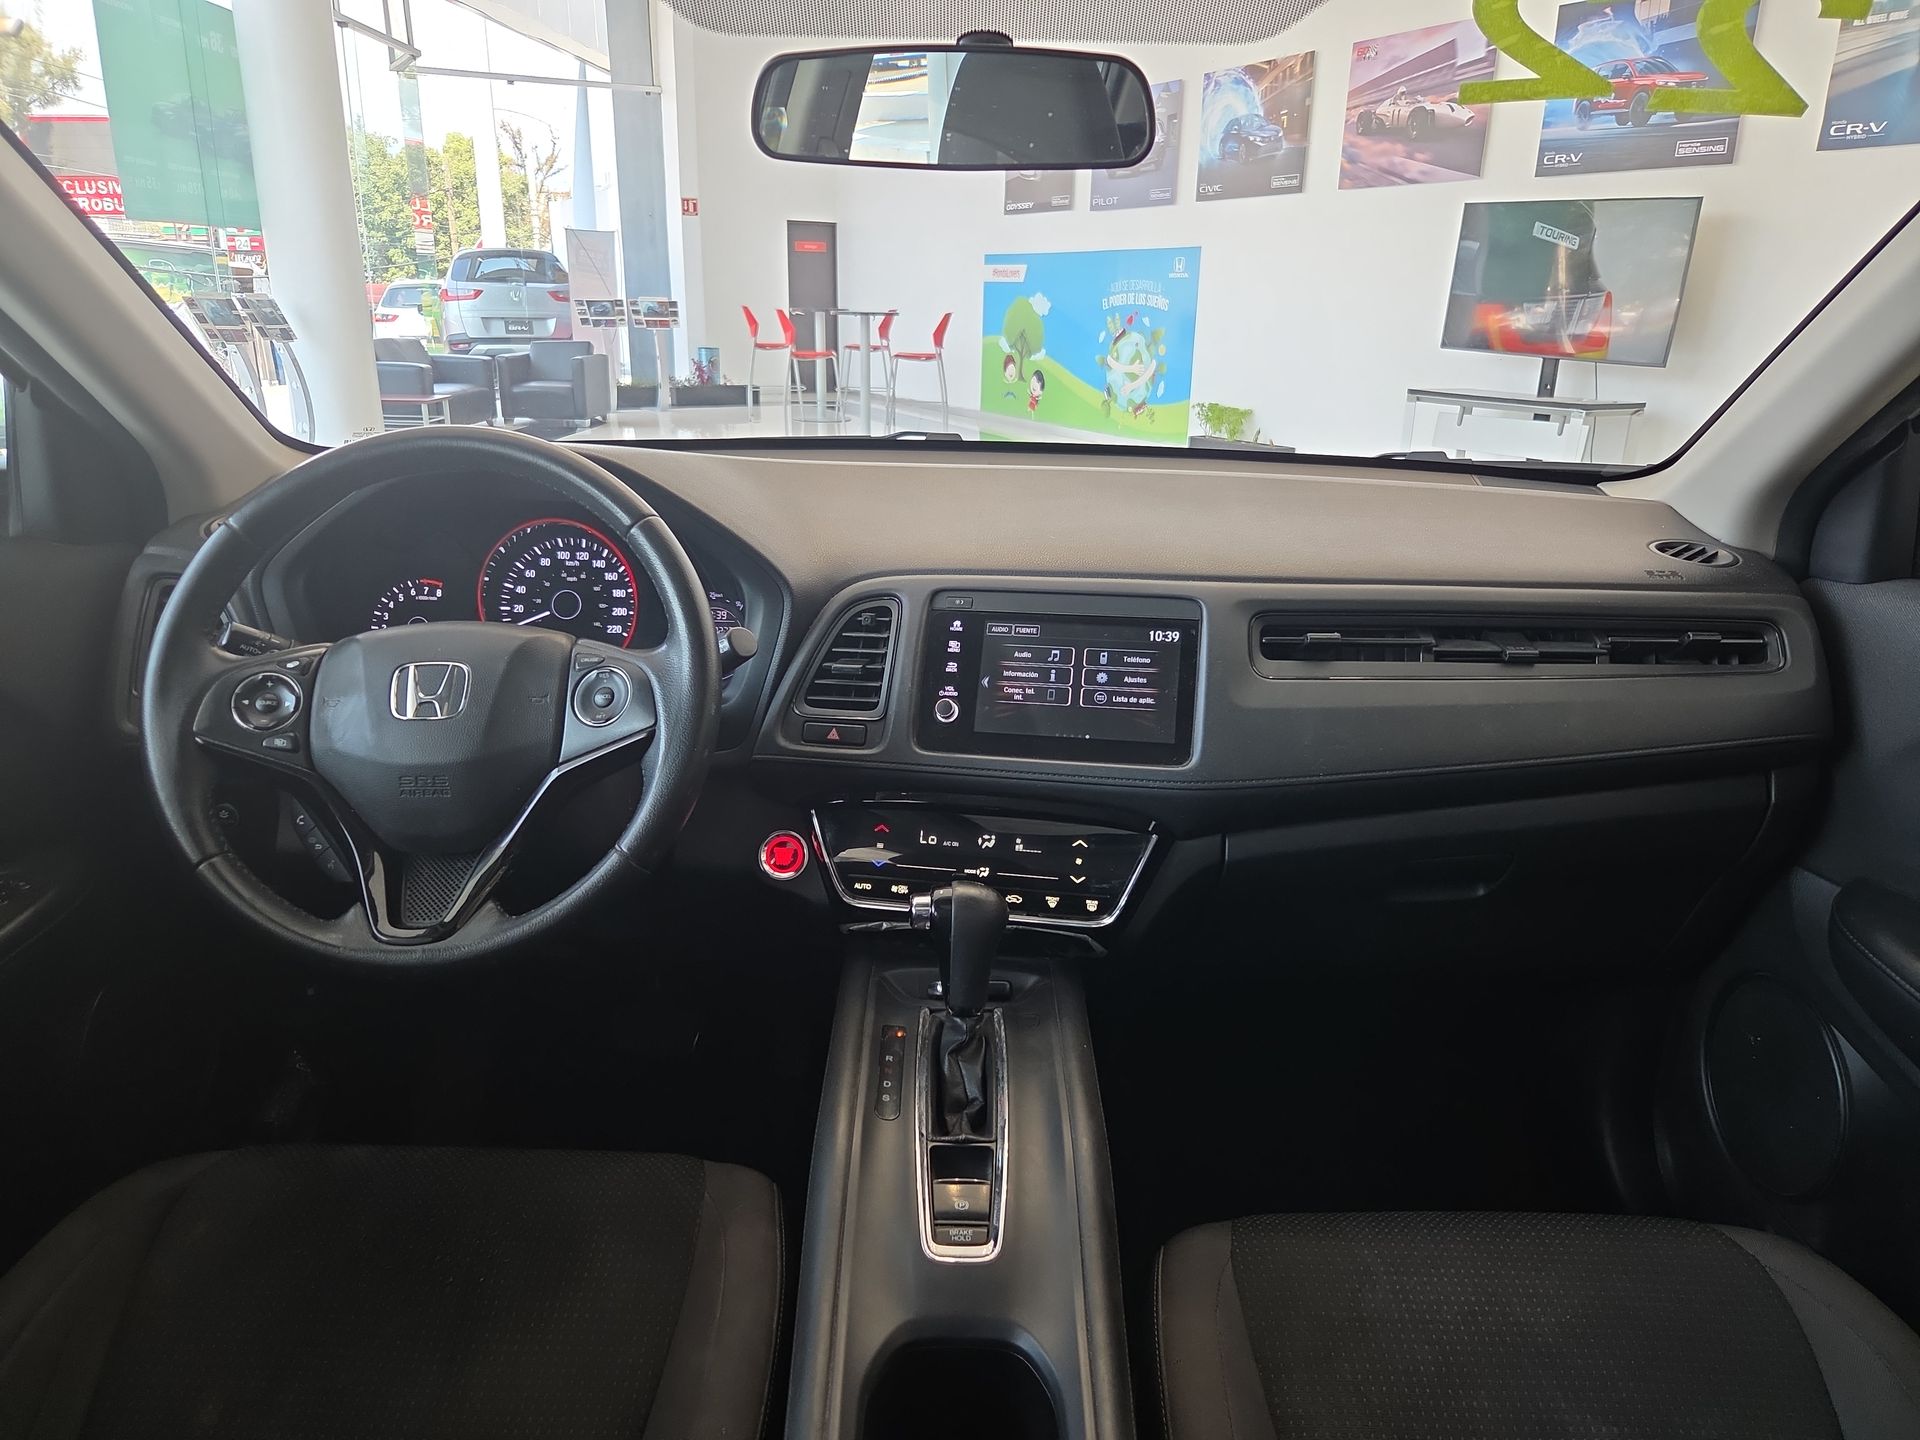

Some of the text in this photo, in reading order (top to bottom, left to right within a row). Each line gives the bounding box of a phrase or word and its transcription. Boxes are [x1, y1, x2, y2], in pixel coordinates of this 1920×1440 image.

[1829, 121, 1888, 136] CR-V
[1678, 144, 1725, 154] SENSING
[1543, 152, 1583, 165] CR-V
[60, 179, 122, 195] CLUSIV
[1199, 184, 1223, 193] CIVIC
[1092, 196, 1119, 206] PILOT
[1006, 202, 1035, 211] ODYSSEY
[1540, 225, 1578, 247] TOURING
[237, 239, 249, 250] 24
[1102, 298, 1109, 310] EL
[1109, 294, 1127, 307] PODER
[1128, 292, 1135, 304] DE
[1136, 292, 1146, 305] LOS
[556, 551, 570, 560] 100
[576, 551, 589, 560] 120
[540, 558, 551, 566] 80
[592, 560, 606, 568] 140
[525, 569, 536, 578] 60
[604, 572, 618, 581] 160
[410, 588, 416, 596] 6
[423, 586, 429, 595] 7
[436, 589, 442, 597] 8
[515, 585, 526, 594] 40
[612, 589, 626, 598] 180
[398, 594, 404, 602] 5
[388, 600, 394, 609] 4
[513, 604, 524, 613] 20
[383, 612, 389, 620] 3
[611, 607, 628, 616] 200
[606, 625, 623, 634] 220
[1149, 630, 1180, 643] 10:39
[1123, 656, 1151, 664] Teléfono
[1003, 670, 1039, 678] Información
[1123, 676, 1147, 684] Ajustes
[1003, 686, 1024, 694] Conec.
[1112, 695, 1128, 703] Lista
[1138, 697, 1156, 705] aplic.
[920, 829, 937, 845] Lo
[854, 882, 872, 890] AUTO
[883, 1080, 892, 1088] D
